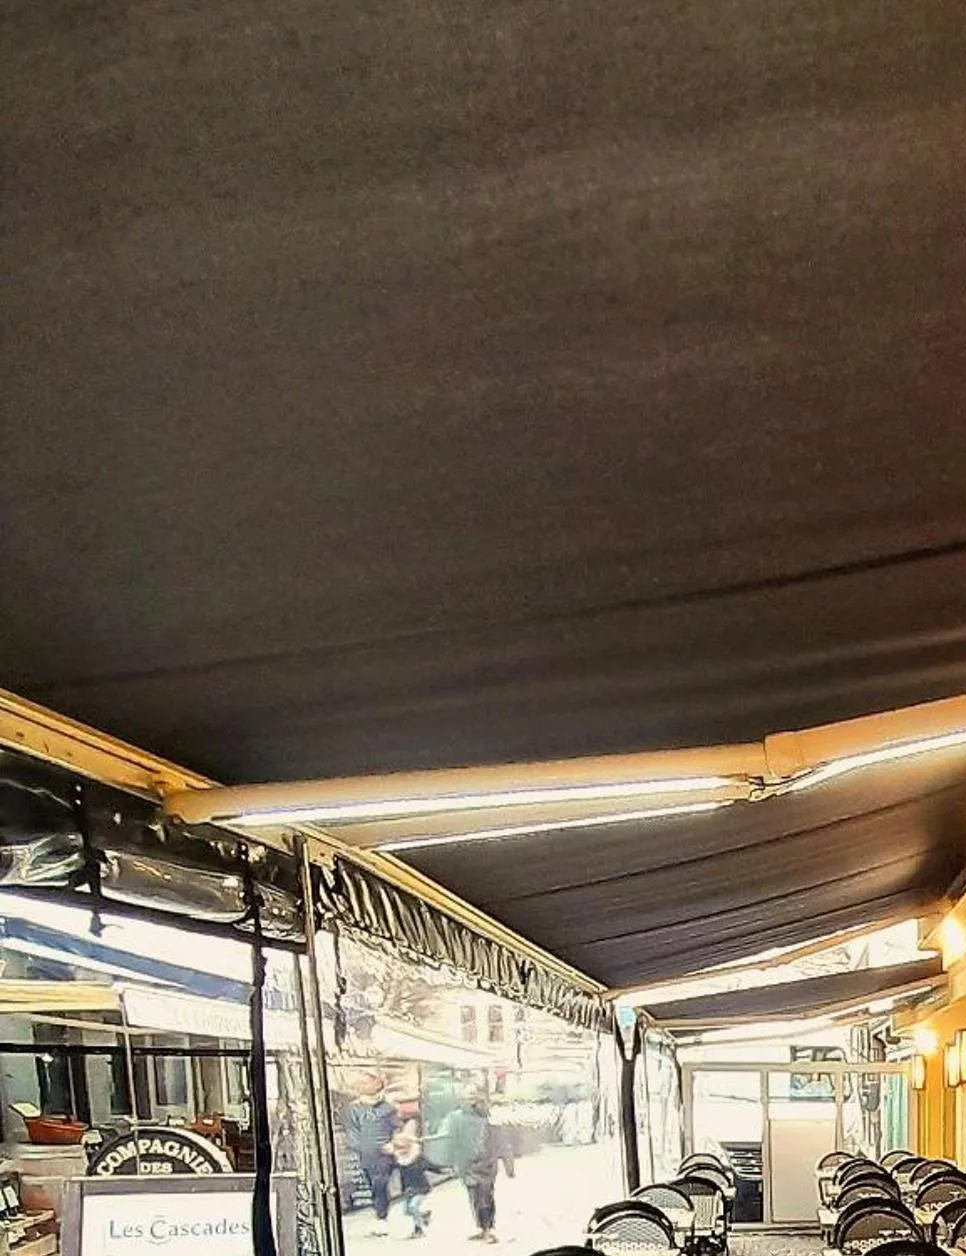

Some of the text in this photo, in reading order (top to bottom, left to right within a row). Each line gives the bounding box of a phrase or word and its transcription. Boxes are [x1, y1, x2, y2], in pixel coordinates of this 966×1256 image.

[97, 1139, 213, 1175] COMPAGNIE
[140, 1161, 173, 1174] DES
[109, 1218, 250, 1240] Les Cascades
